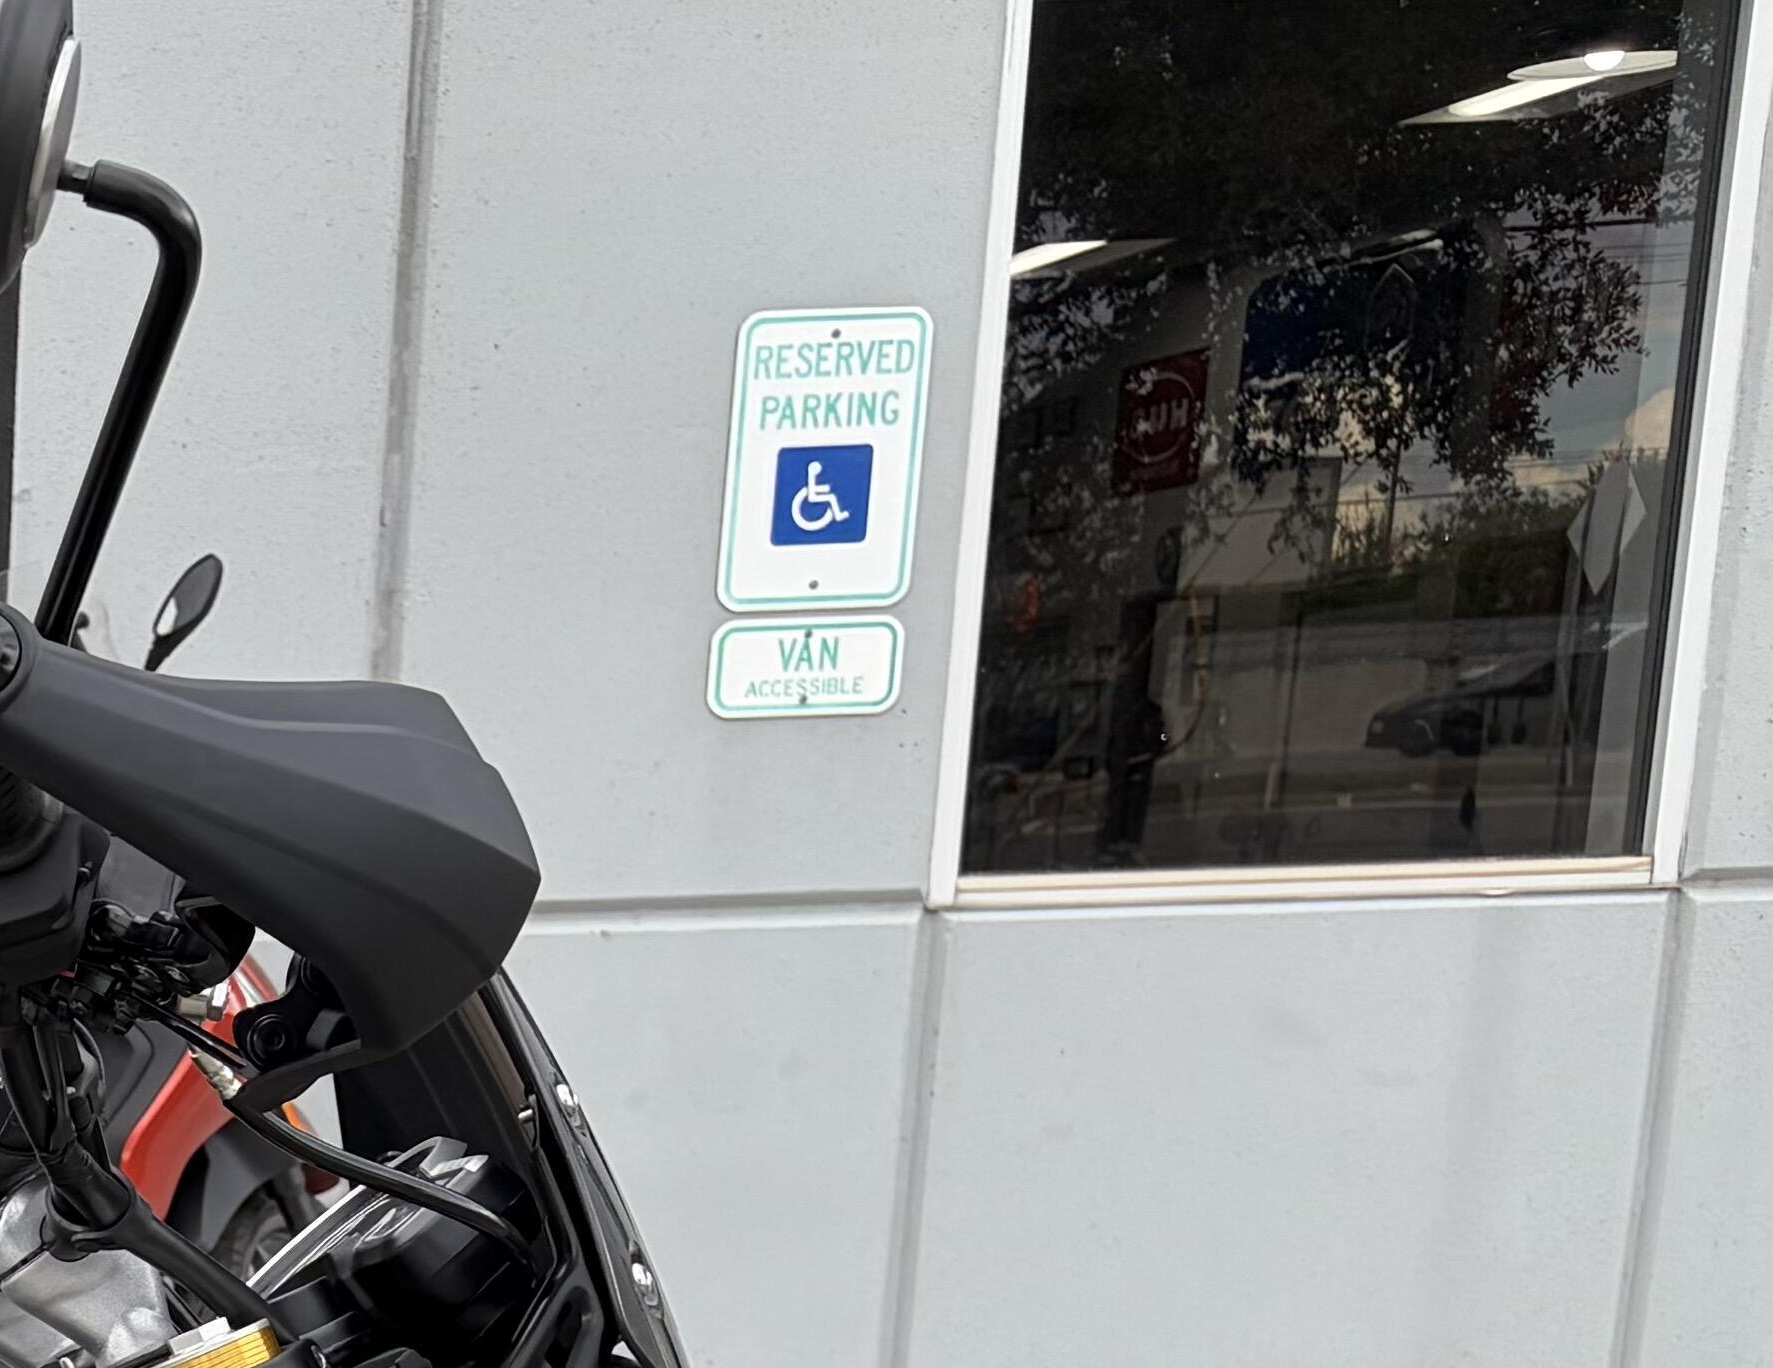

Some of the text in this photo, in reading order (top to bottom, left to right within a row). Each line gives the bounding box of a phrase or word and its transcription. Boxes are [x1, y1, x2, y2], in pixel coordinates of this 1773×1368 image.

[754, 339, 915, 381] RESERVED
[759, 390, 900, 431] PARKING
[778, 636, 839, 672] VAN
[744, 675, 864, 700] ACCESSIBLE
